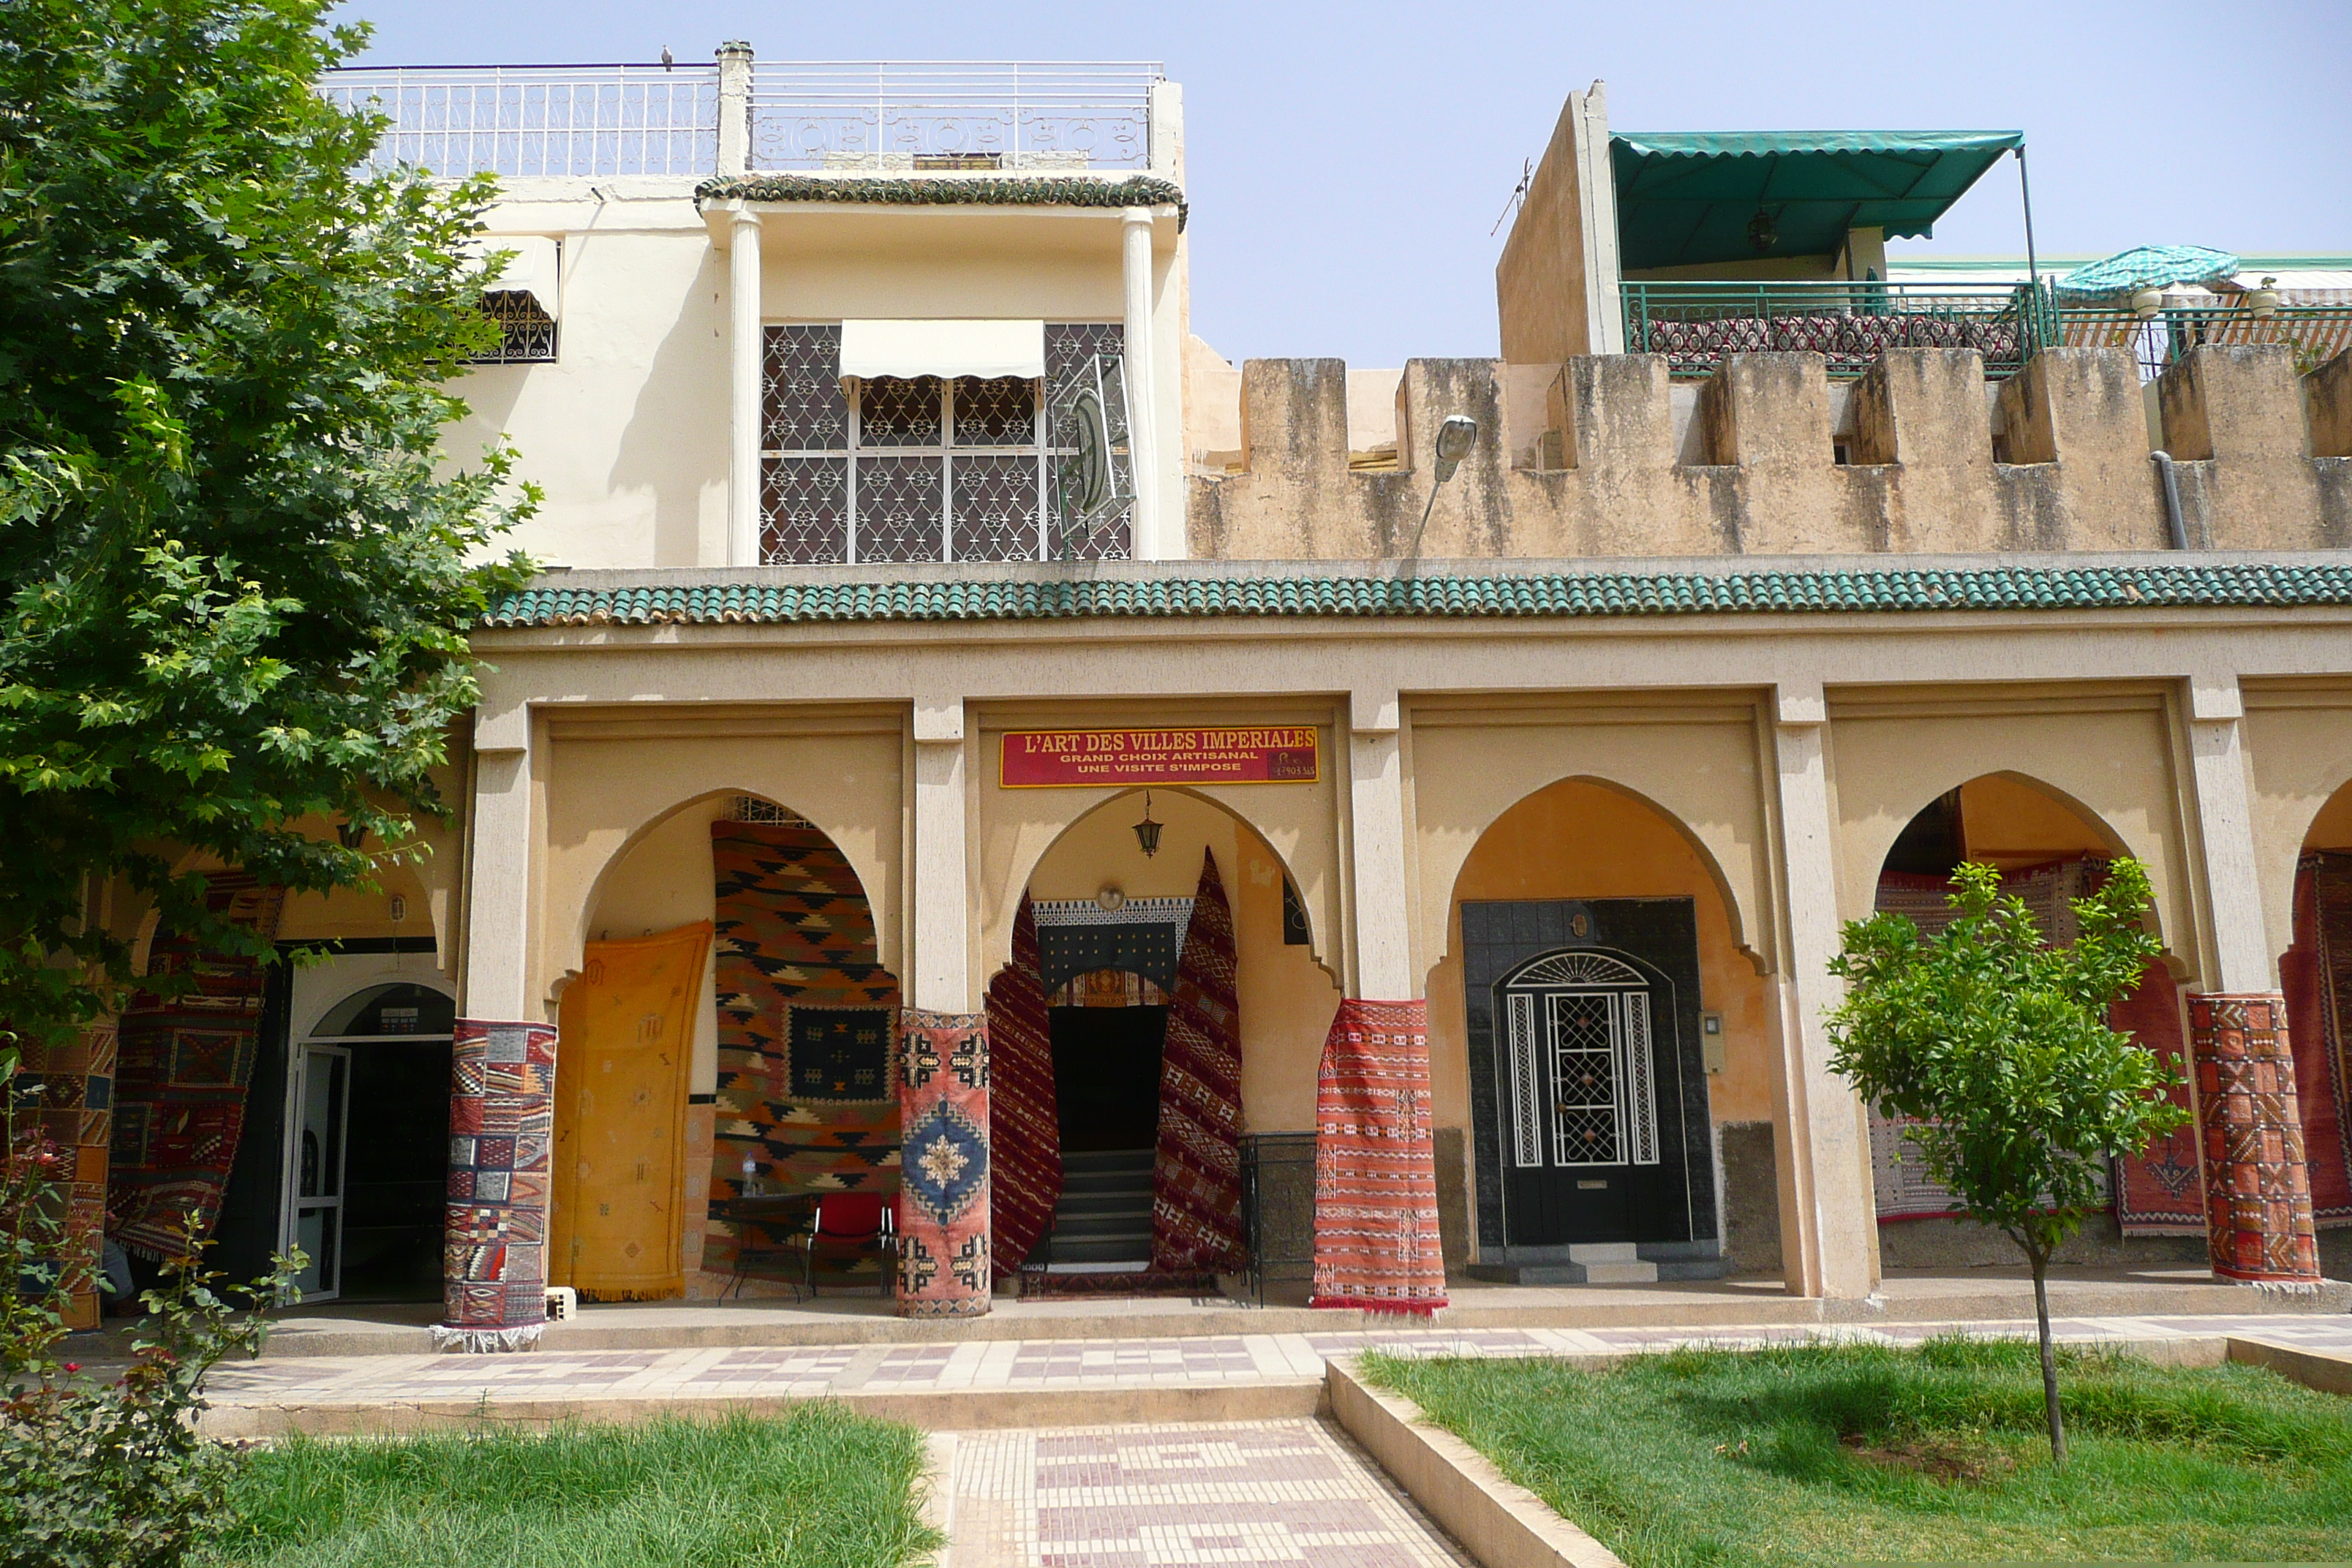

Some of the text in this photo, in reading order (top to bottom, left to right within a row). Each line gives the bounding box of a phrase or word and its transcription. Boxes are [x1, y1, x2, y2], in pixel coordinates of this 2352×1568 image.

[1025, 730, 1314, 753] L'ART DES VILLES IMPERIALES
[1119, 753, 1167, 761] CHOIX
[1172, 752, 1259, 760] ARTISANAL
[1078, 763, 1241, 773] UNE VISITE S'IMPOSE
